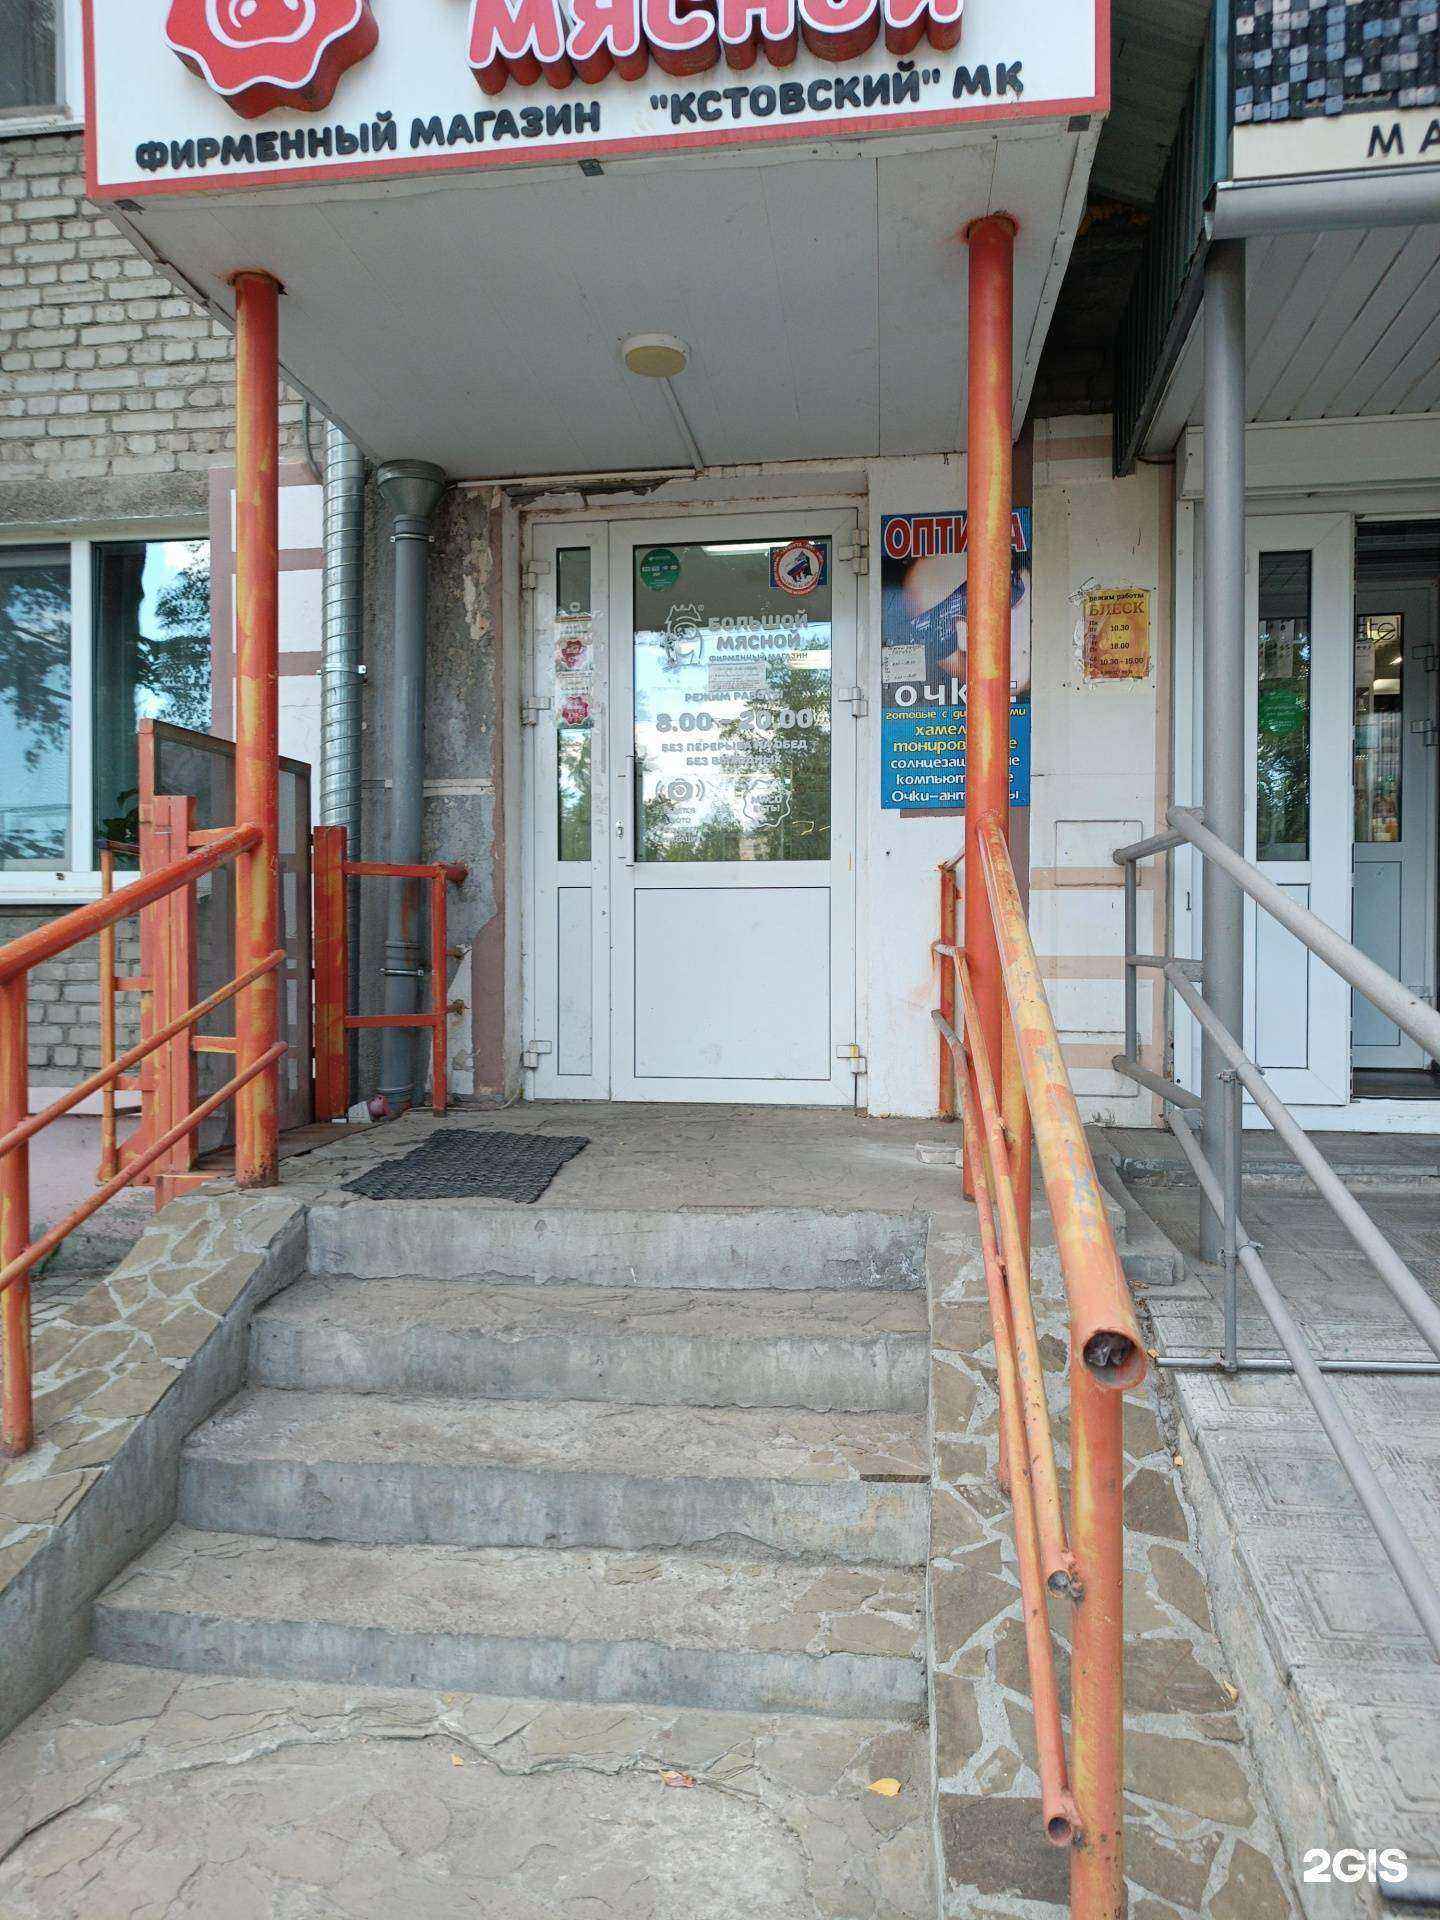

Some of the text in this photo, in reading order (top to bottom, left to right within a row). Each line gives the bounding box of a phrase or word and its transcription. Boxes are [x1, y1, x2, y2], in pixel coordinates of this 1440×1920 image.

[135, 60, 1024, 172] ФИРМЕННЫЙ МАГАЗИН "КСТОВСКИЙ" МК
[884, 512, 1027, 559] ОПТИА
[1117, 591, 1144, 600] работы
[1090, 601, 1145, 616] БЛЕСК
[708, 609, 808, 631] БОЛЬШОЙ
[1111, 624, 1130, 632] 10.30
[716, 630, 801, 650] МЯСНОЙ
[709, 652, 766, 662] ФИРМЕННЫЙ
[685, 692, 731, 702] РЕЖИМ
[886, 711, 937, 720] готовые
[656, 712, 713, 732] 8.00
[662, 743, 684, 752] БЕЗ
[686, 756, 709, 766] БЕЗ
